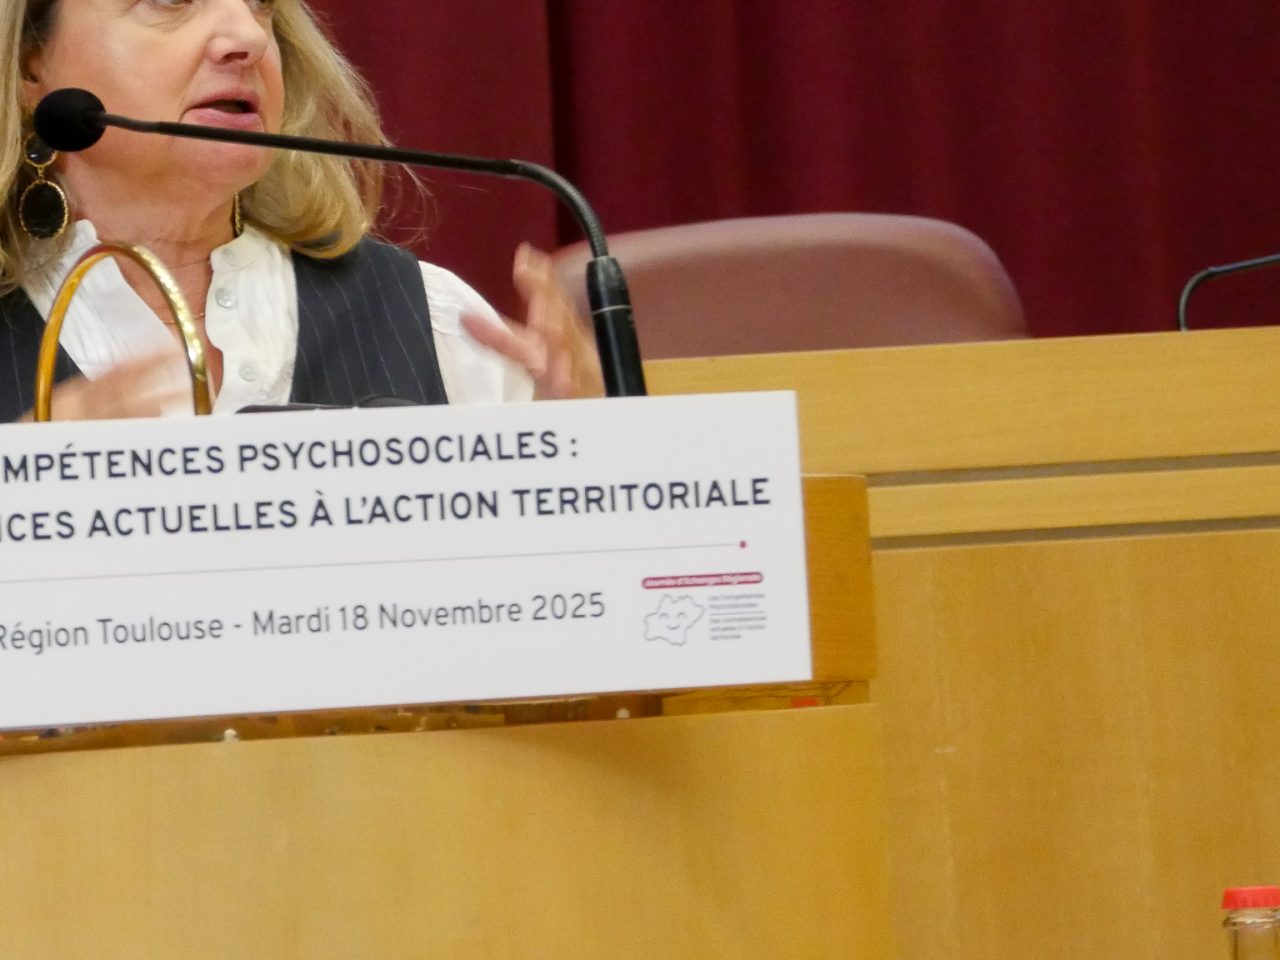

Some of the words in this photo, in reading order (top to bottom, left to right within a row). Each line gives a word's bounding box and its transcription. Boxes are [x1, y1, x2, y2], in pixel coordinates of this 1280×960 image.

[238, 430, 560, 473] PSYCHOSOCIALES
[87, 499, 298, 538] ACTUELLES
[309, 489, 334, 528] À
[344, 490, 500, 526] L’ACTION
[511, 477, 772, 517] TERRITORIALE
[96, 616, 224, 645] Toulouse
[252, 606, 331, 636] Mardi
[337, 604, 370, 631] 18
[378, 599, 523, 629] Novembre
[532, 591, 606, 621] 2025
